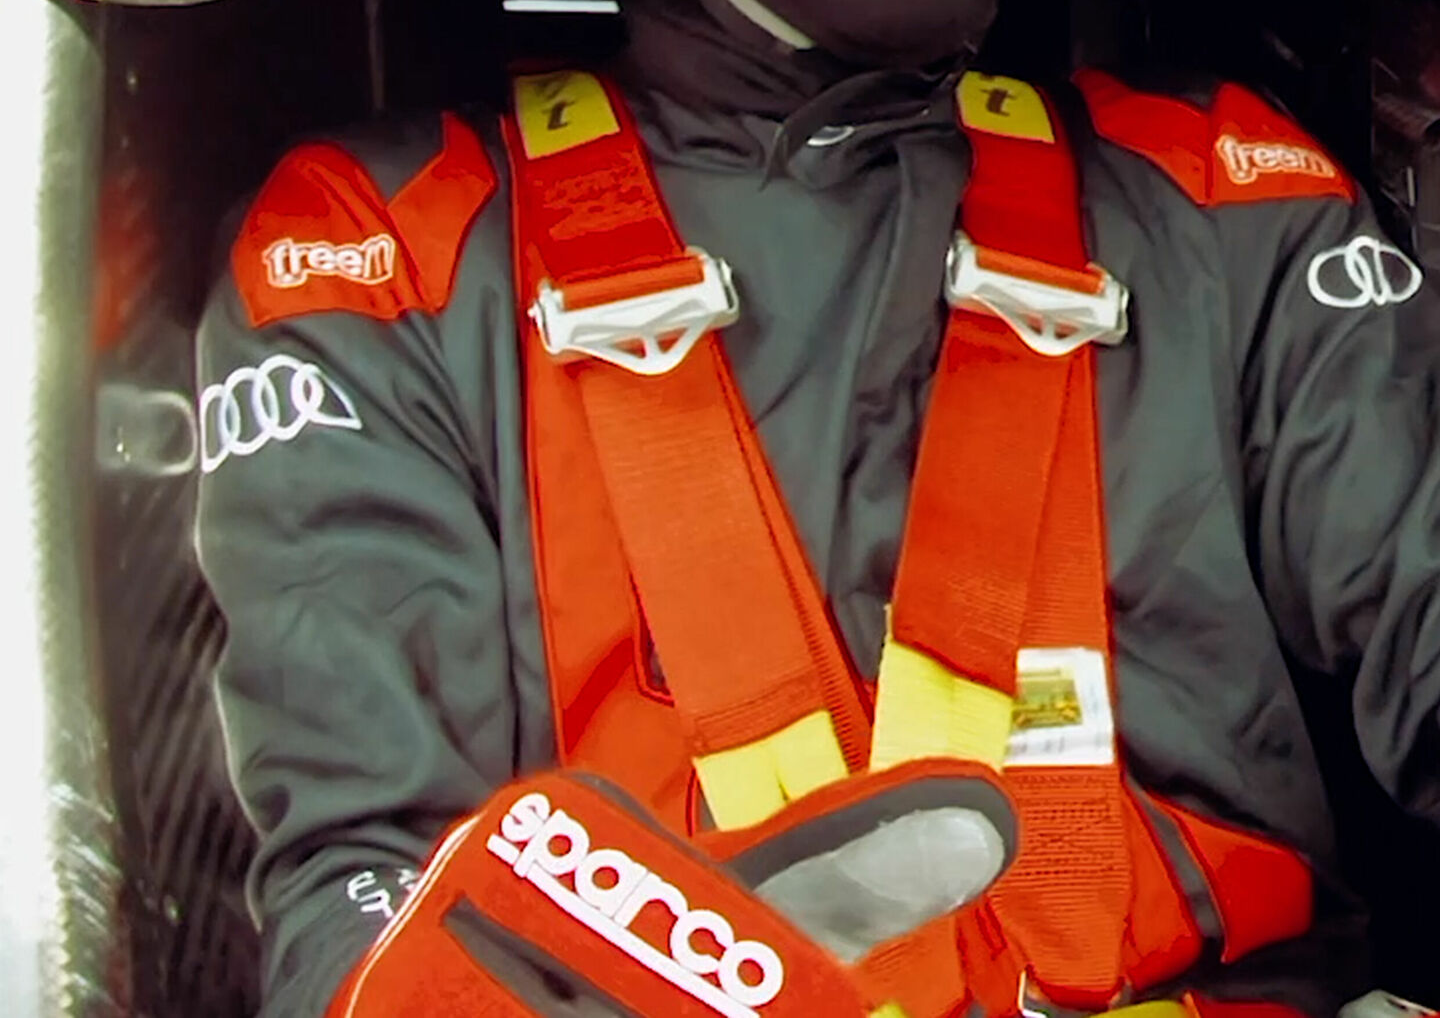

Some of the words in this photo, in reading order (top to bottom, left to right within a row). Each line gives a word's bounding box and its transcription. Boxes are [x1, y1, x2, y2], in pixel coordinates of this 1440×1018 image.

[1216, 134, 1335, 184] freem
[262, 233, 395, 288] freem
[500, 792, 785, 1008] sparco
